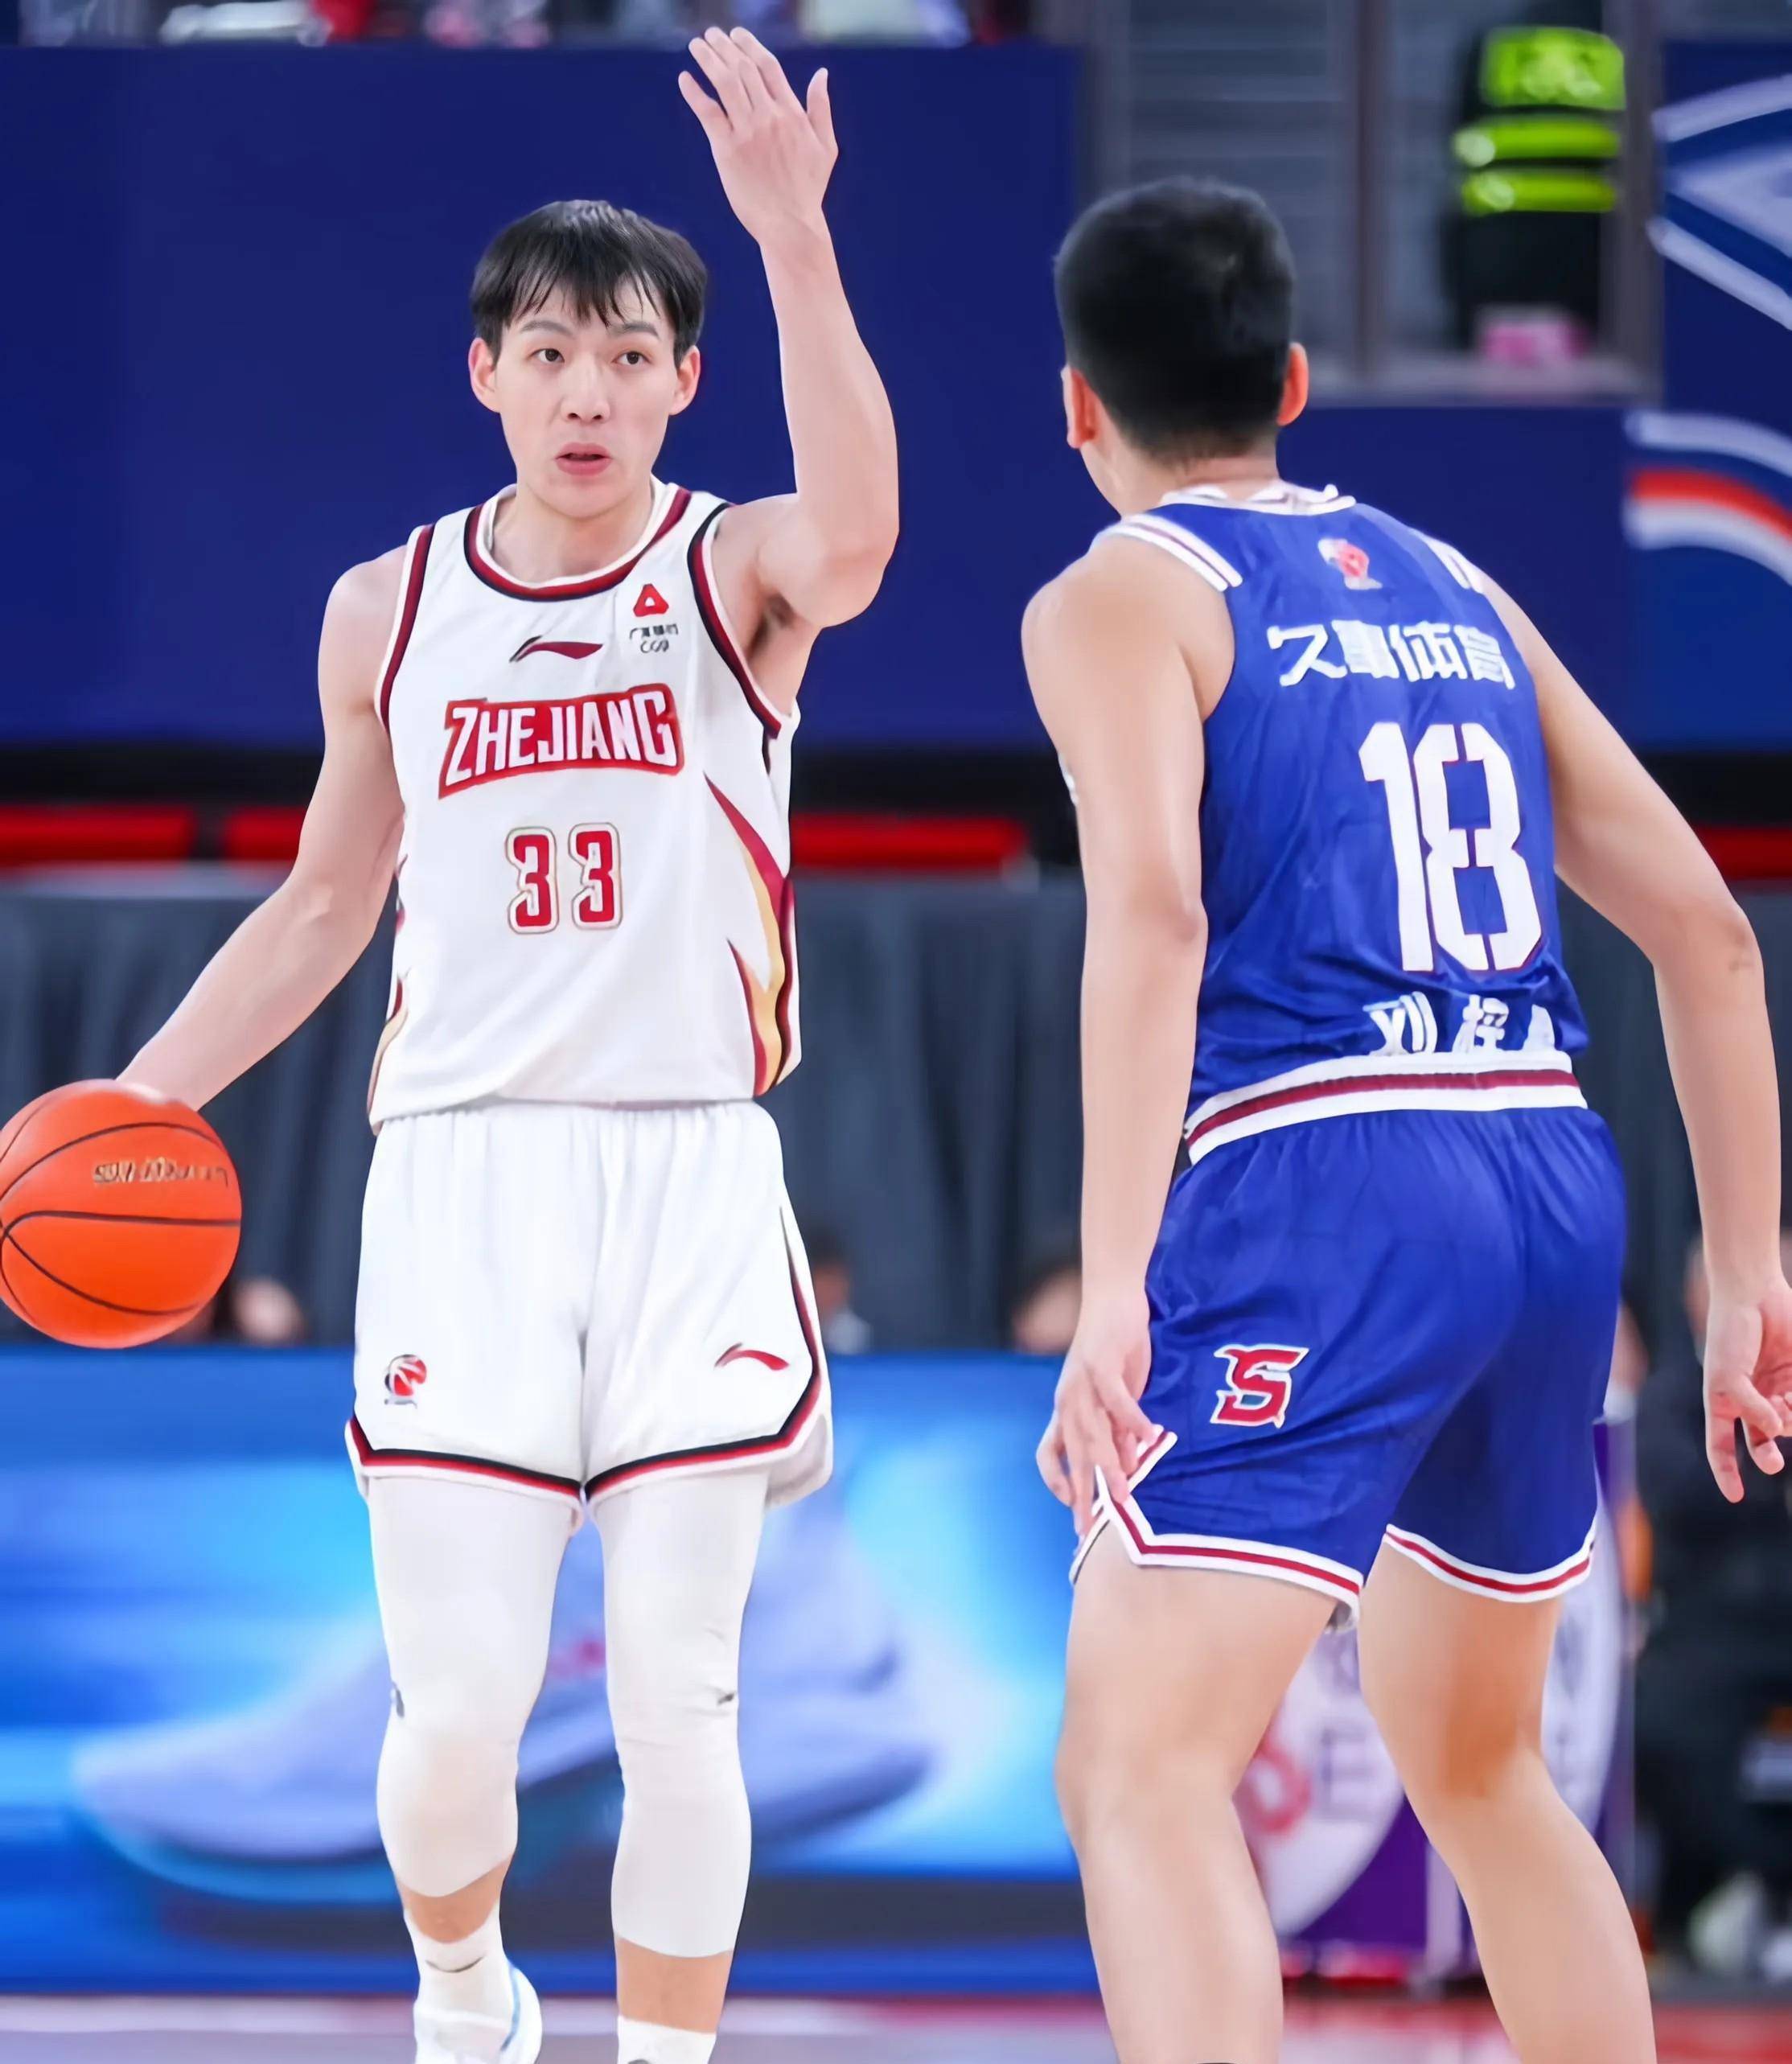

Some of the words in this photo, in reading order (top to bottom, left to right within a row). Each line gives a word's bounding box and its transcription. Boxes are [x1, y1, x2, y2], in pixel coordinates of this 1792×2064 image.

[446, 690, 678, 787] ZHEJIANG
[506, 822, 623, 935] 33
[1358, 722, 1543, 972] 18
